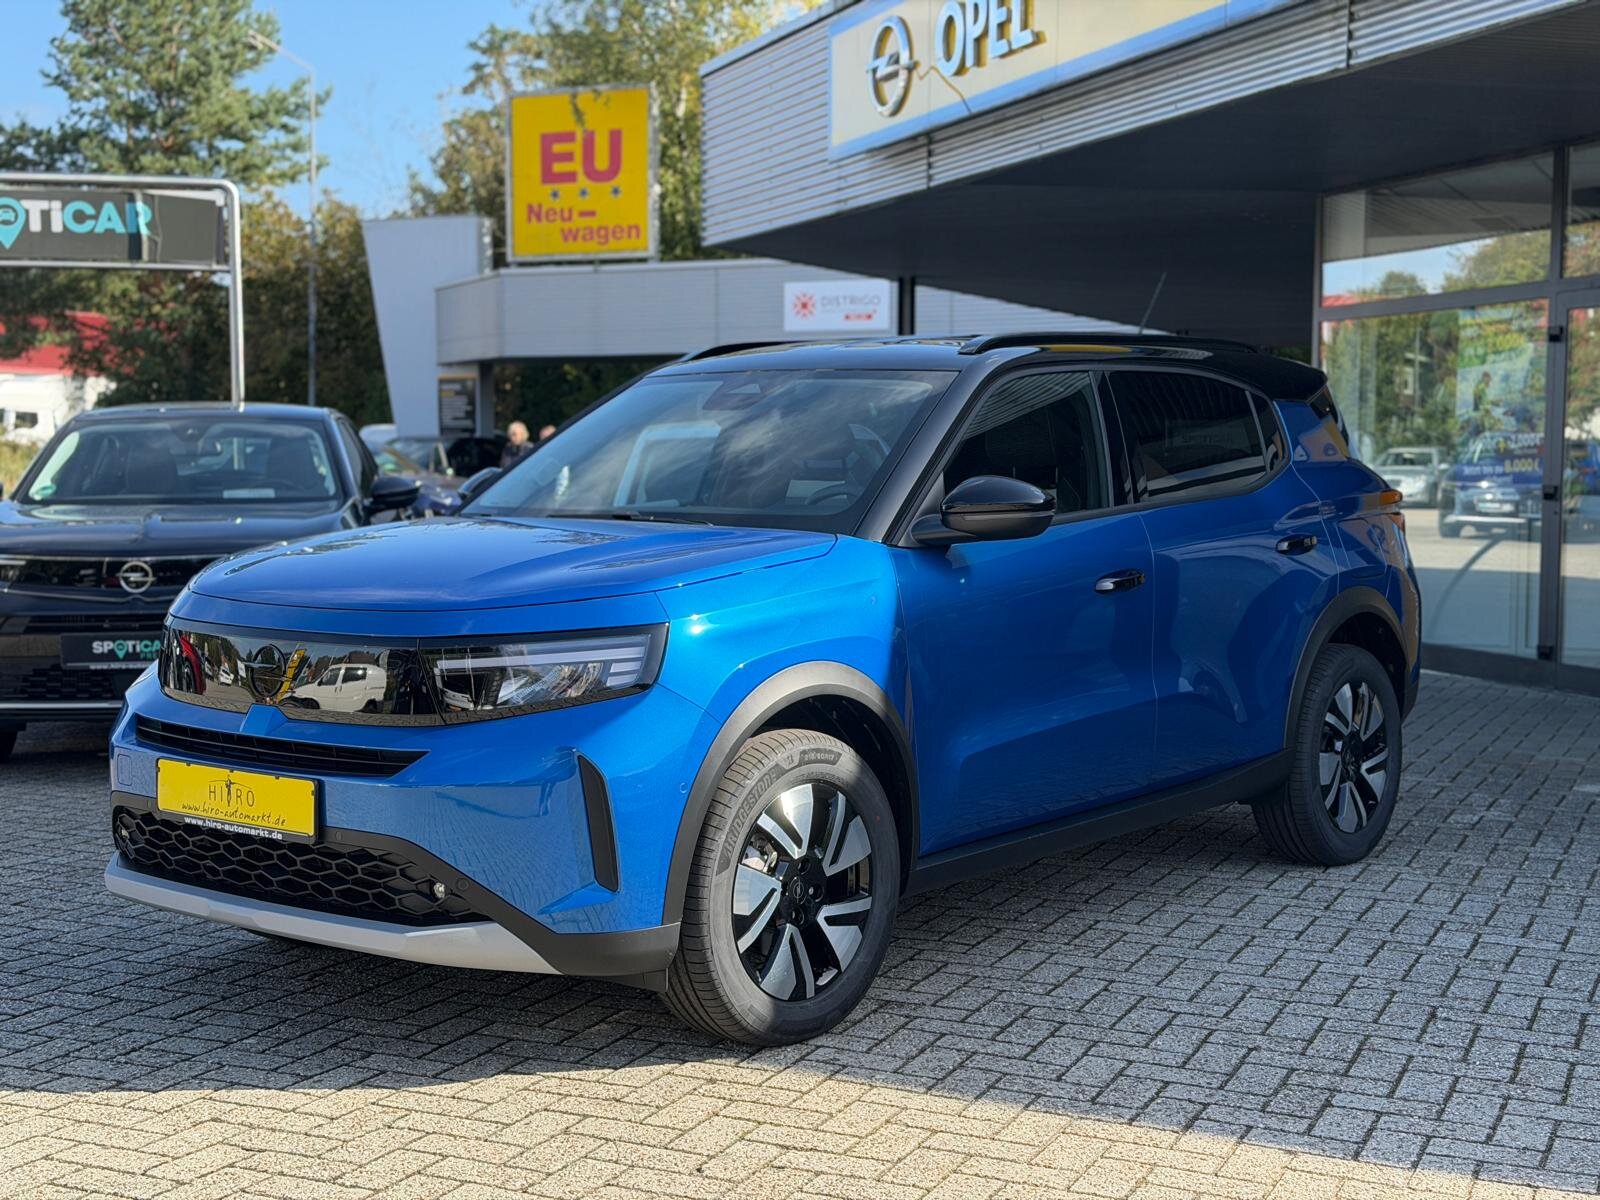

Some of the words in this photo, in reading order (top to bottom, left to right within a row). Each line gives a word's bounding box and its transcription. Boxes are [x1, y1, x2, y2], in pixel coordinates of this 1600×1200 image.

[934, 0, 1036, 77] OPEL
[540, 128, 623, 185] EU
[560, 223, 641, 246] wagen
[821, 294, 881, 307] DISTRIGO
[208, 784, 255, 808] HIRO
[182, 801, 286, 826] www.hiro-automarkt.de
[720, 768, 778, 858] BRIDGESTONE
[184, 816, 283, 840] www.hiro-automarkt.de
